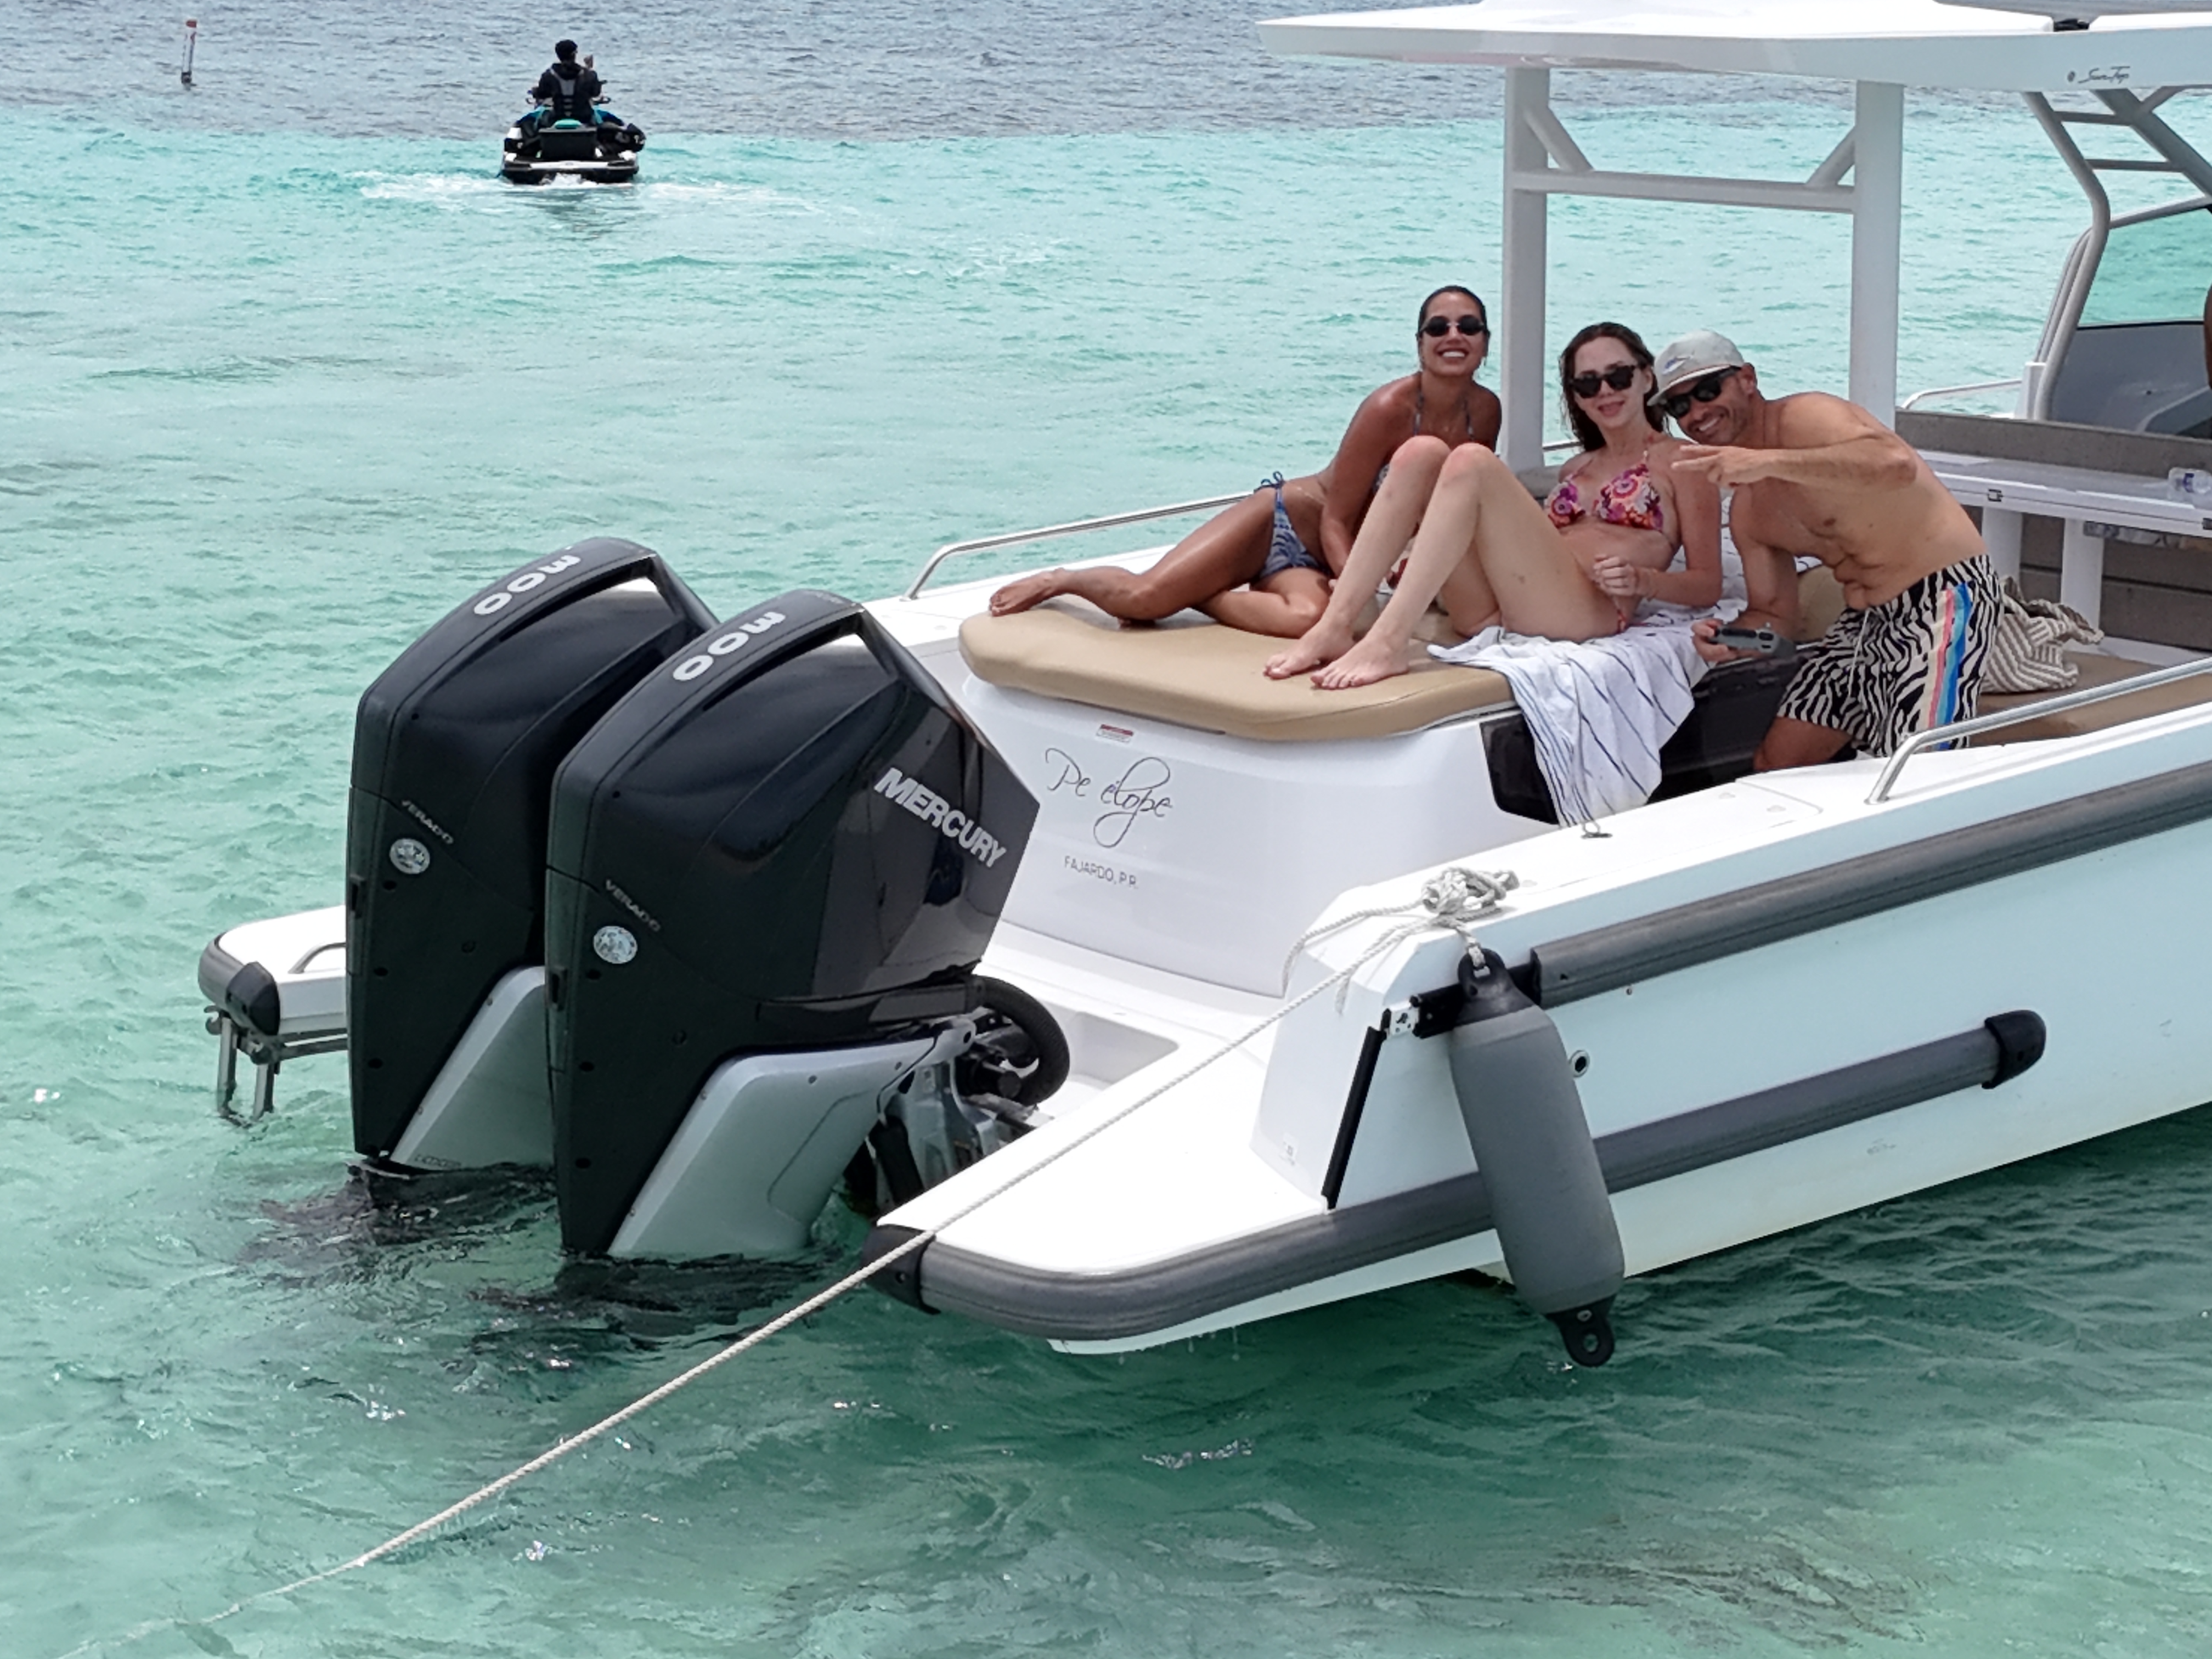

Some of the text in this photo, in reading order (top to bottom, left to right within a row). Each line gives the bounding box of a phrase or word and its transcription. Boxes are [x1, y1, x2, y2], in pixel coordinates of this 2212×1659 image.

[473, 555, 581, 616] 300
[673, 611, 786, 681] 300
[873, 768, 1007, 868] MERCURY
